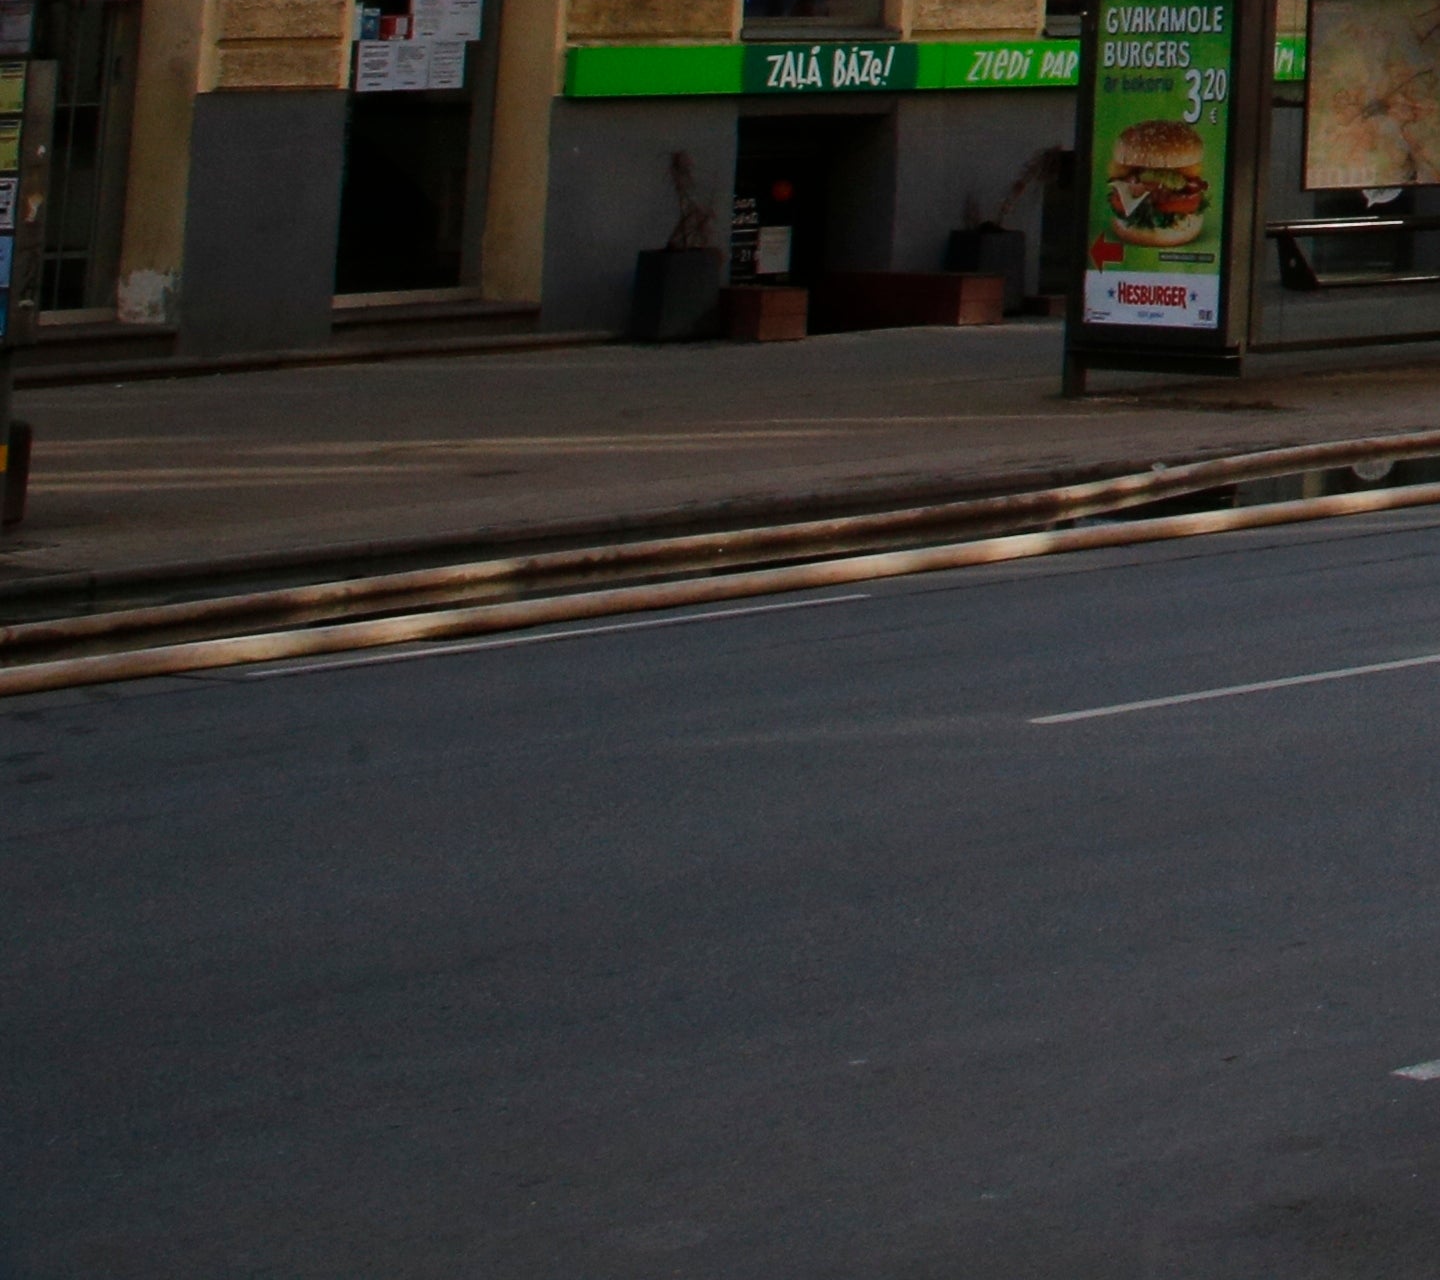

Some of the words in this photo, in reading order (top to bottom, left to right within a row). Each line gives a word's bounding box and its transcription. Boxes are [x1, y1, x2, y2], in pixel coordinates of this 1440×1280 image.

[1105, 4, 1224, 35] GVAKAMOLE
[1103, 40, 1191, 68] BURGERS
[1117, 281, 1188, 309] HESBURGER
